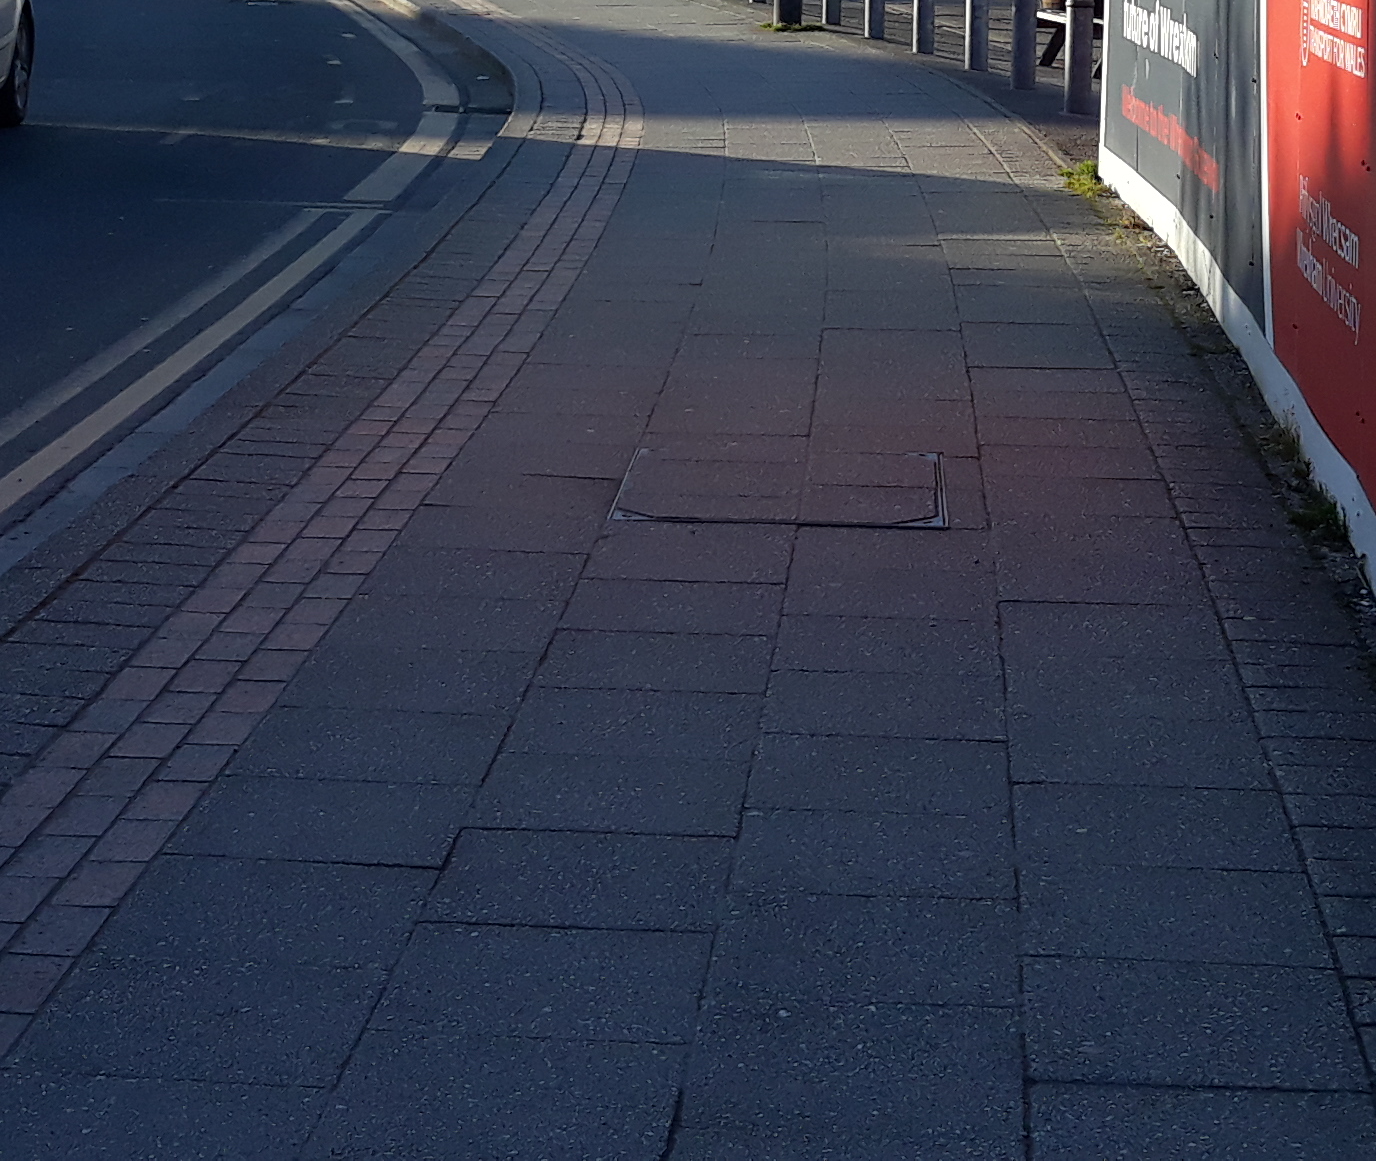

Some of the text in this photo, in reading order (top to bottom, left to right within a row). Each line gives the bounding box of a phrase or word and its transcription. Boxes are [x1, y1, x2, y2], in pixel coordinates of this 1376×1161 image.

[1149, 0, 1160, 54] of
[1160, 5, 1197, 79] Wrexham
[1344, 41, 1366, 78] WALES
